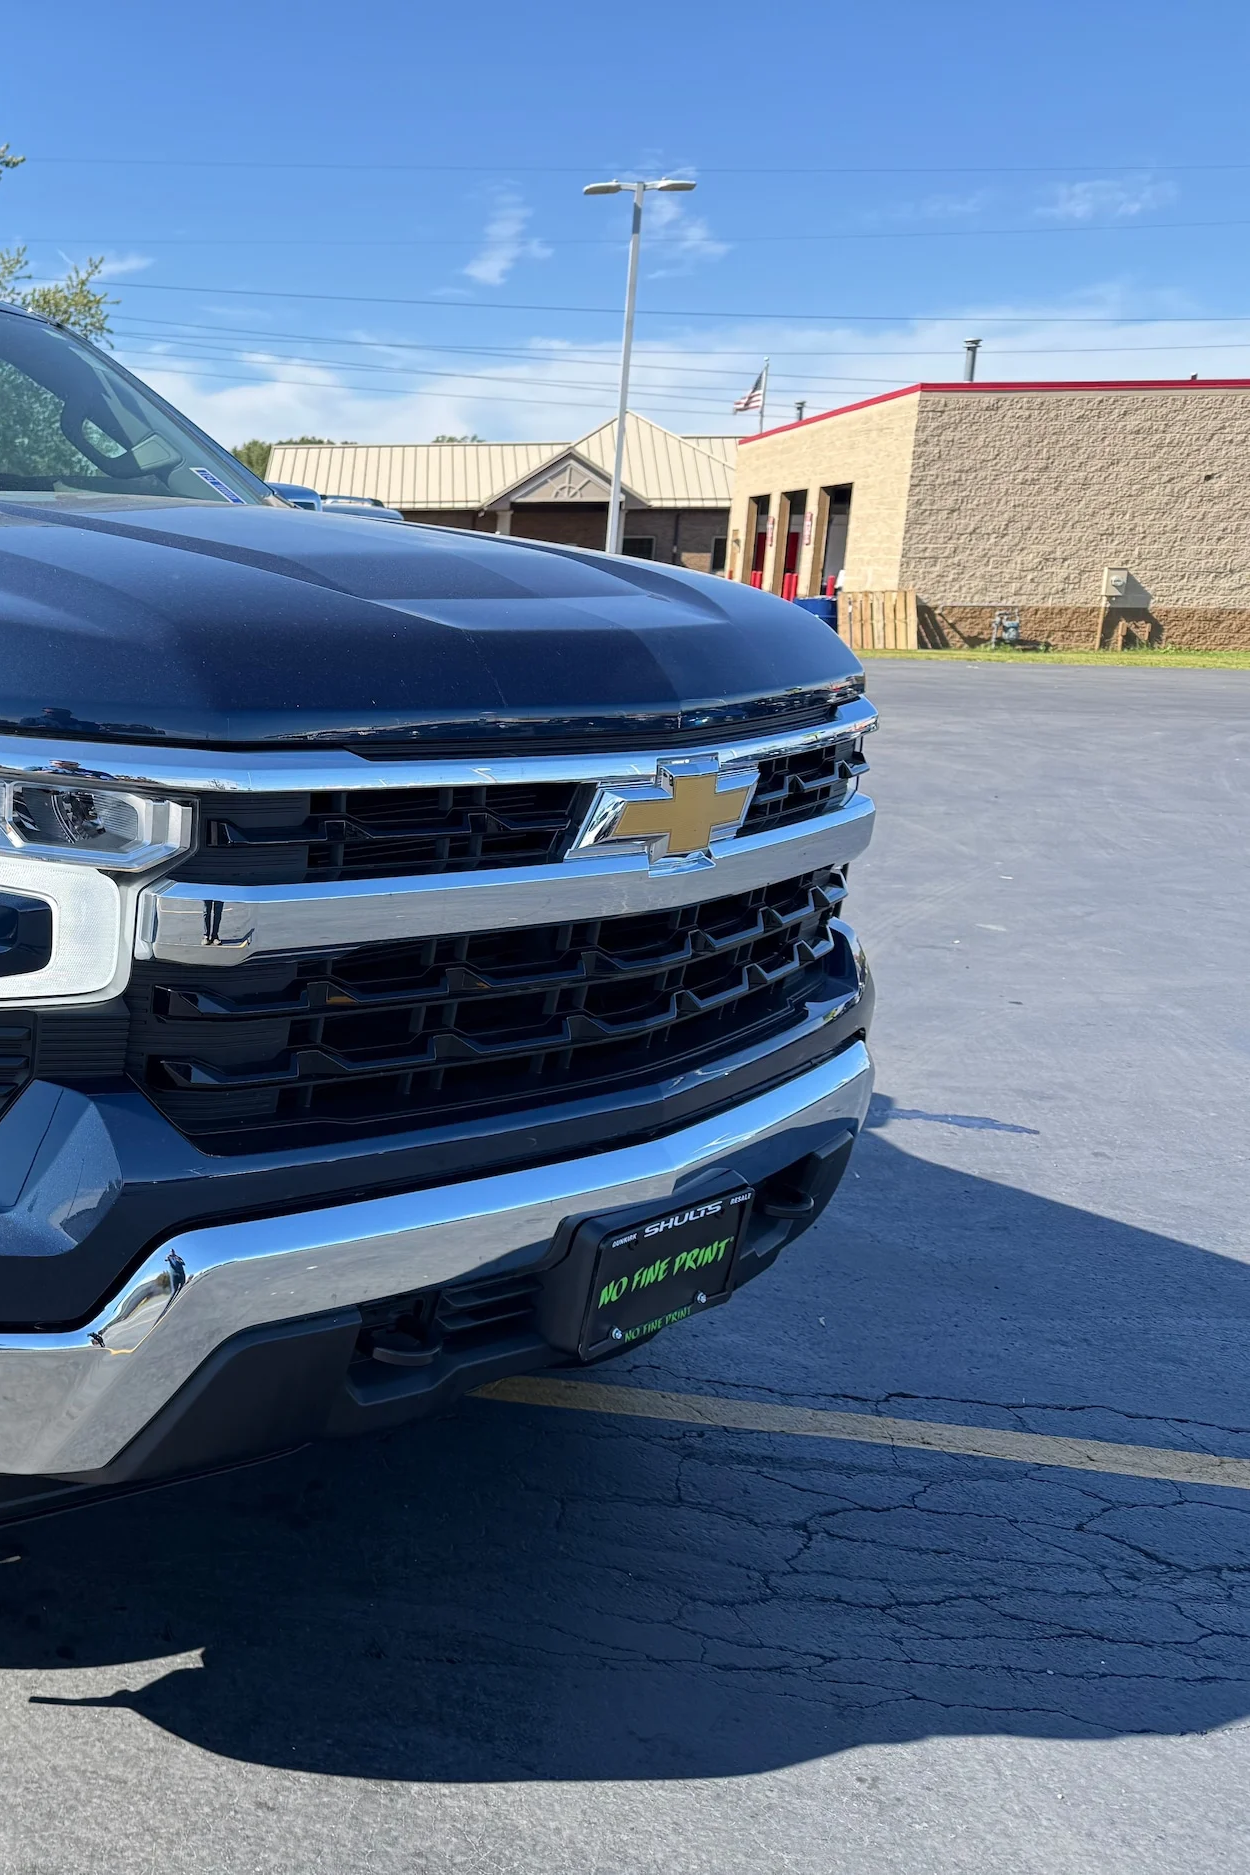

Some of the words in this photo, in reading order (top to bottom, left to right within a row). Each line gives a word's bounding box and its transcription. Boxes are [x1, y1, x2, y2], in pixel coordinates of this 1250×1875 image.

[612, 1232, 638, 1248] DUNKIRK
[644, 1200, 723, 1238] SHULTS
[598, 1276, 629, 1309] NO
[631, 1256, 672, 1292] FINE
[624, 1327, 641, 1343] NO
[643, 1317, 663, 1335] FINE
[665, 1305, 693, 1325] PRINT
